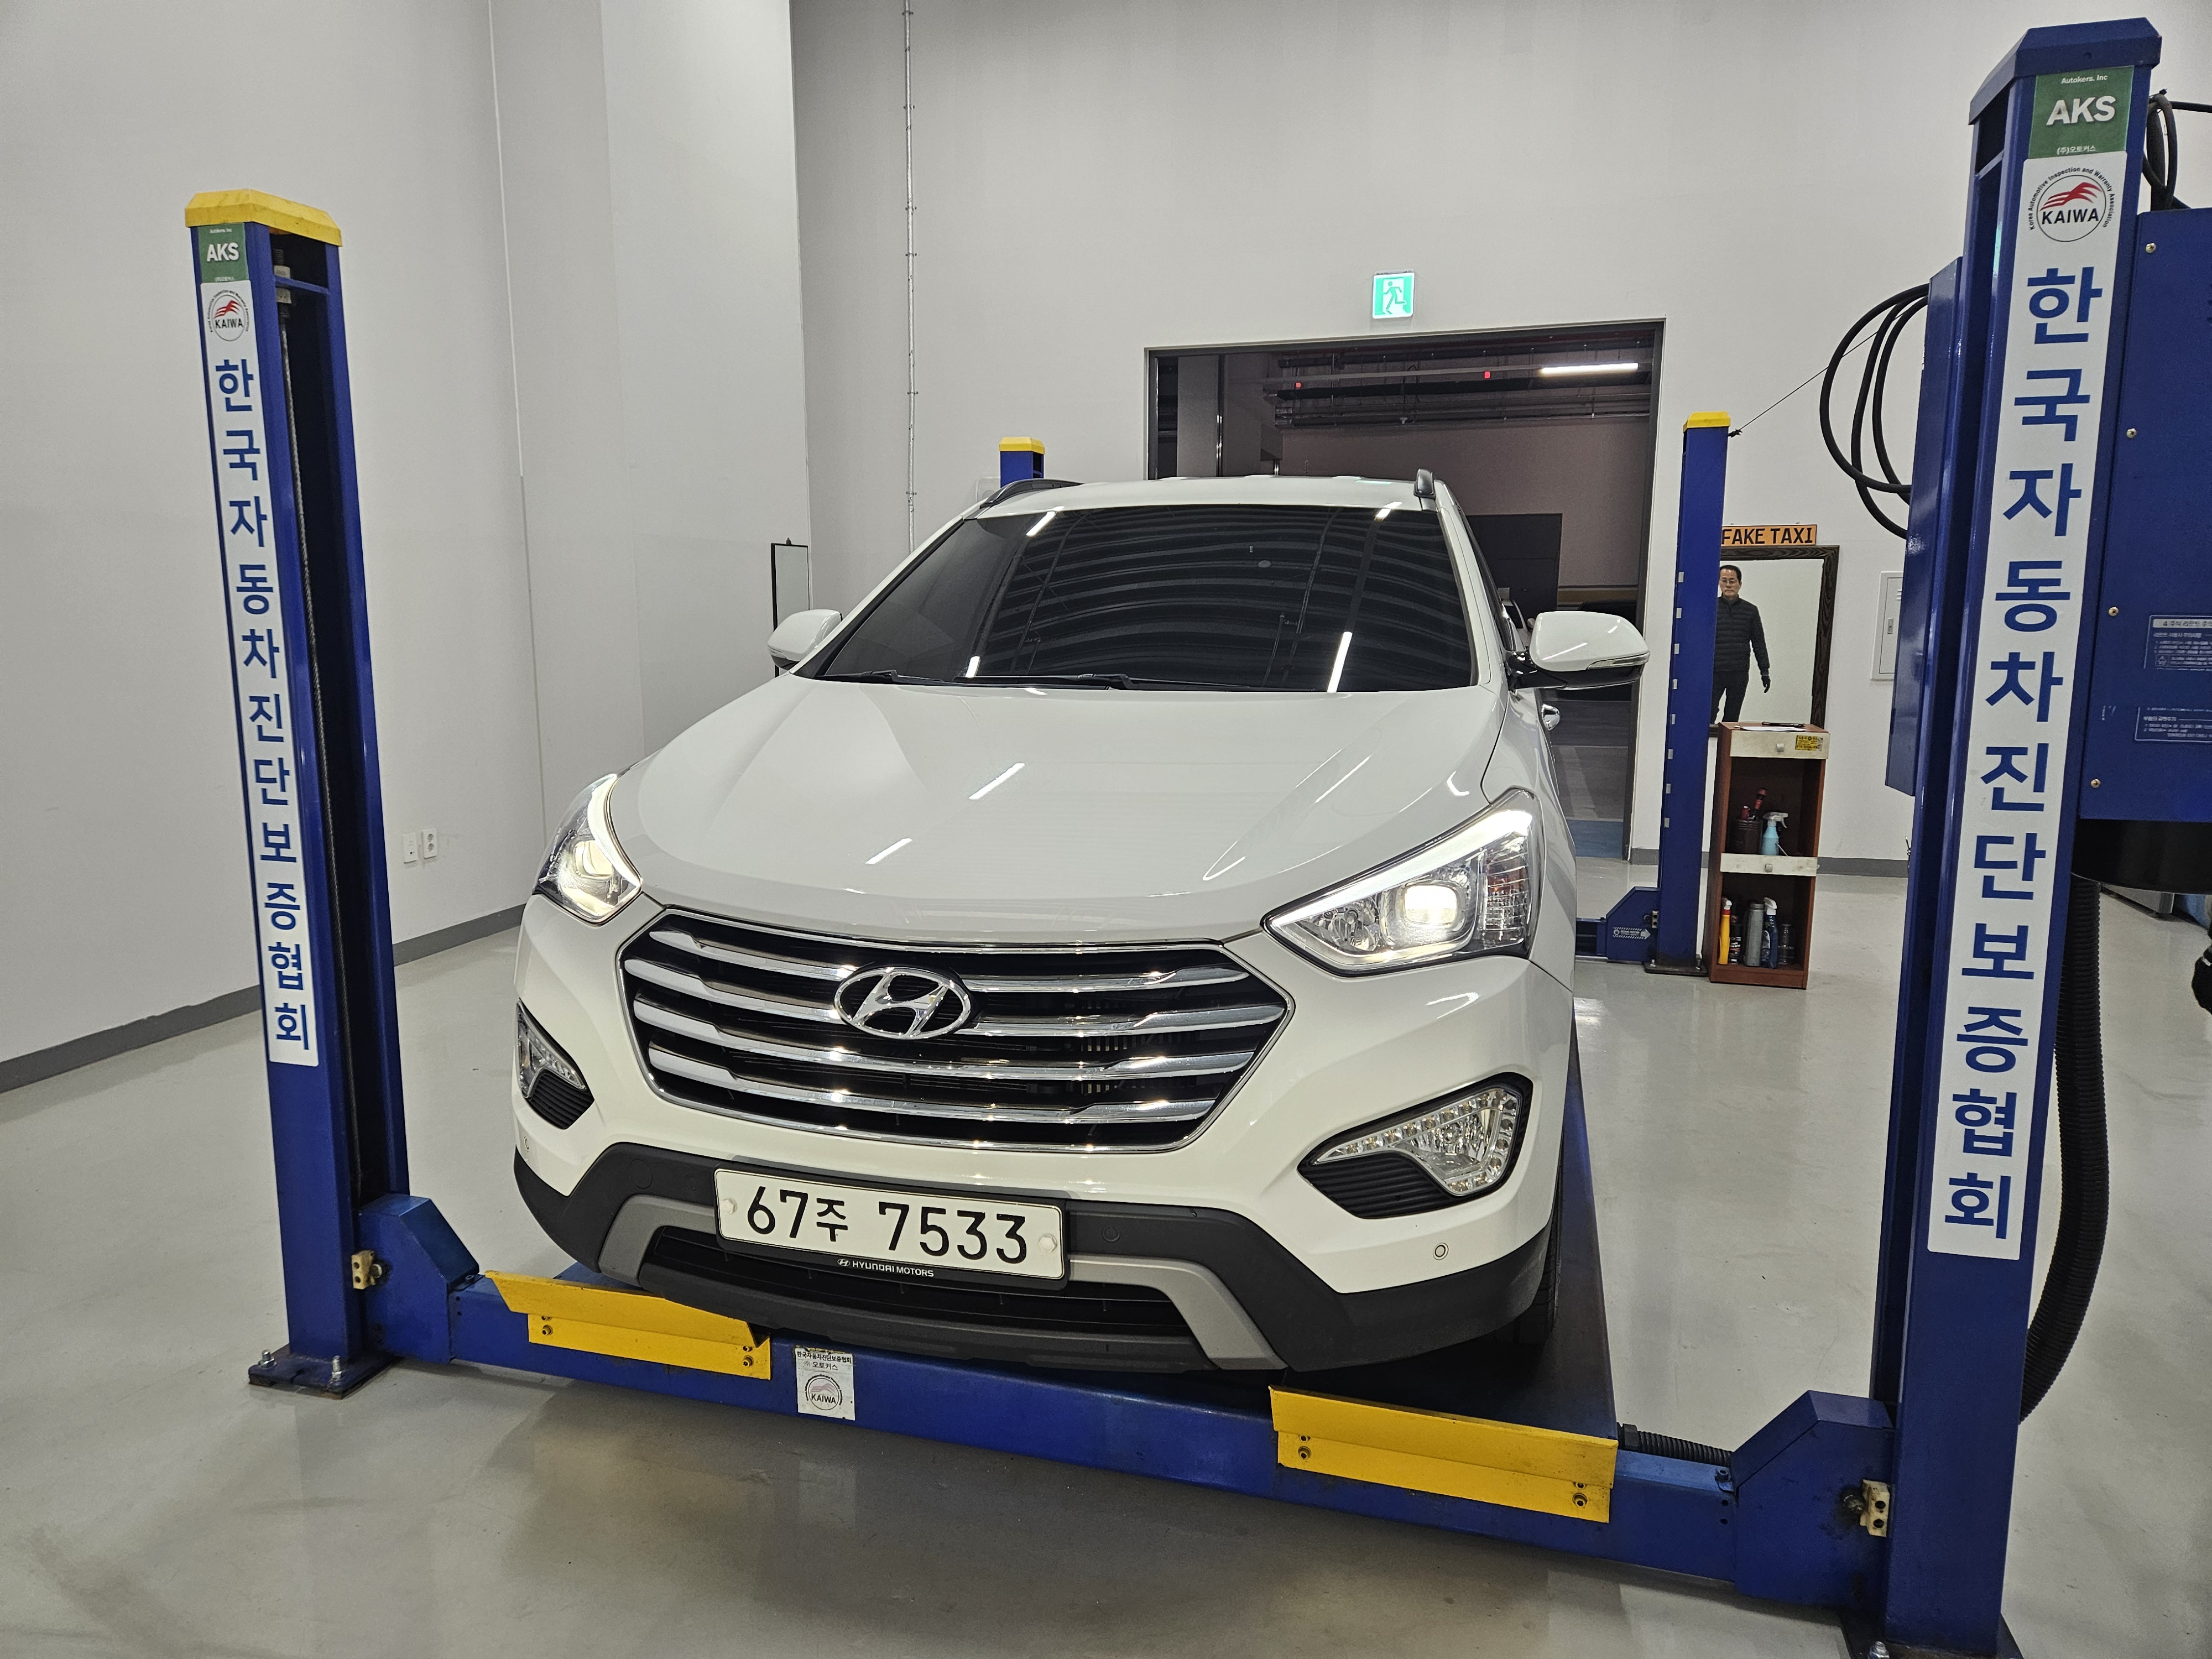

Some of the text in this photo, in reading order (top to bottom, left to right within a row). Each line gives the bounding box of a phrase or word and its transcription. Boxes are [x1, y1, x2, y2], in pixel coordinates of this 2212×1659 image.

[2046, 95, 2116, 126] AKS
[2048, 166, 2081, 181] Inspection
[2094, 170, 2113, 192] Warranty
[2027, 180, 2048, 211] Automotive
[2042, 207, 2099, 225] KAIWA
[2102, 193, 2116, 228] Association
[207, 242, 239, 262] AKS
[215, 318, 244, 329] KAIWA
[1721, 527, 1813, 545] FAKE TAXI
[215, 359, 309, 1050] 한국자동차진단보증협회
[1945, 267, 2103, 1239] 한국자동차진단보증협회
[747, 1186, 1027, 1264] 67주 7533
[852, 1260, 934, 1277] HYUNDAI MOTORS
[797, 1350, 852, 1364] 한국자동차진단보증협회
[811, 1393, 836, 1404] KAIWA
